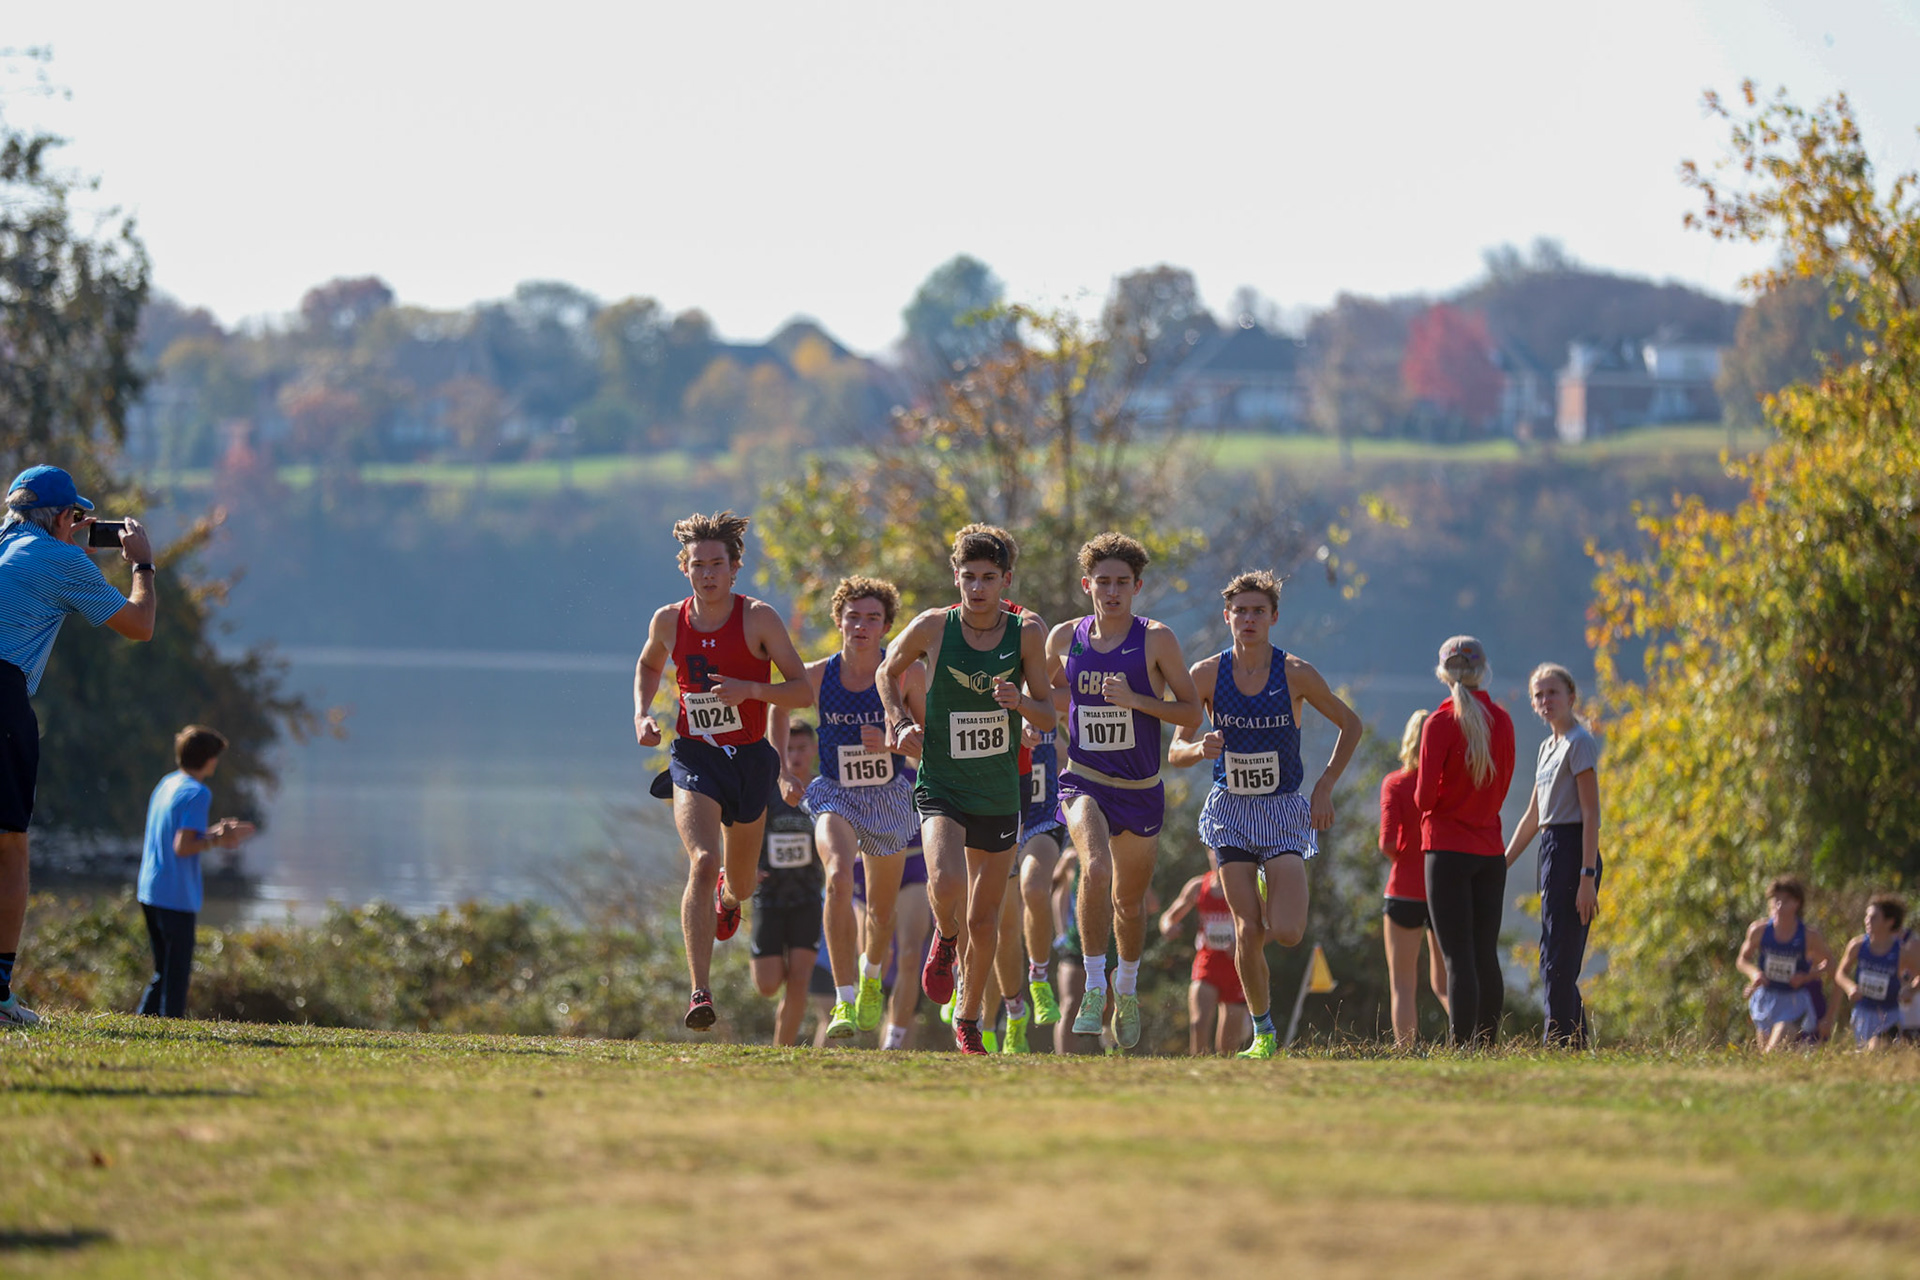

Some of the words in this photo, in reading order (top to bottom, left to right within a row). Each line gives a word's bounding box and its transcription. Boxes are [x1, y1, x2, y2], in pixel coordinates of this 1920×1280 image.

[1078, 670, 1126, 695] CB
[690, 706, 736, 729] 1024
[825, 711, 884, 725] McCALL
[979, 716, 996, 724] STATE
[1216, 713, 1290, 729] McCALLIE
[956, 727, 1004, 751] 1138
[1085, 722, 1127, 744] 1077
[844, 759, 887, 780] 1156
[1249, 757, 1265, 765] STATE
[1231, 767, 1275, 789] 1155
